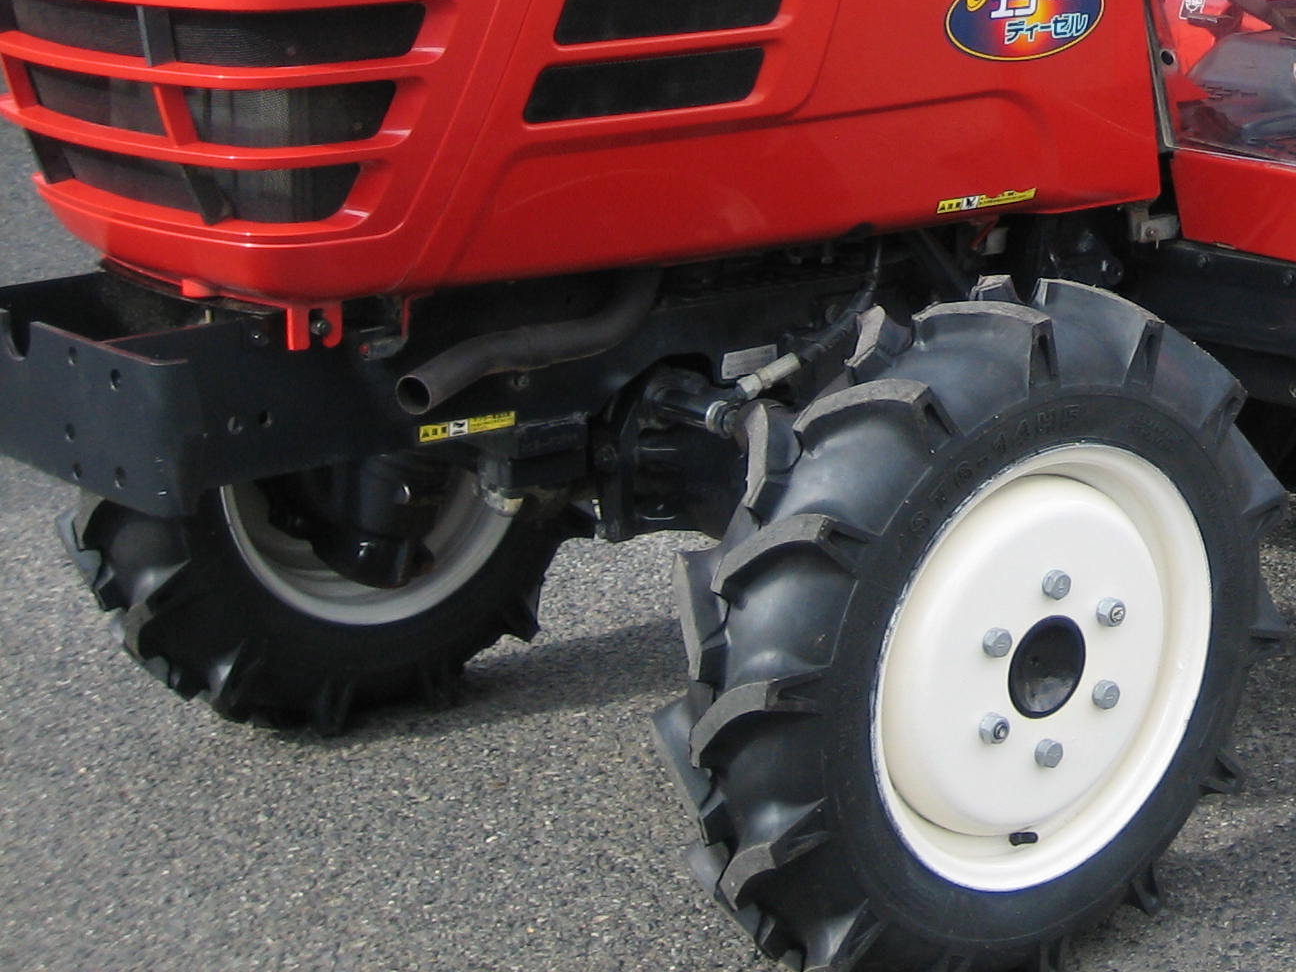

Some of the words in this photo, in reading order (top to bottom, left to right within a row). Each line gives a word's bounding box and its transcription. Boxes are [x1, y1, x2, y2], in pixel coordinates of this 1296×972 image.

[1004, 12, 1089, 45] ディーゼル
